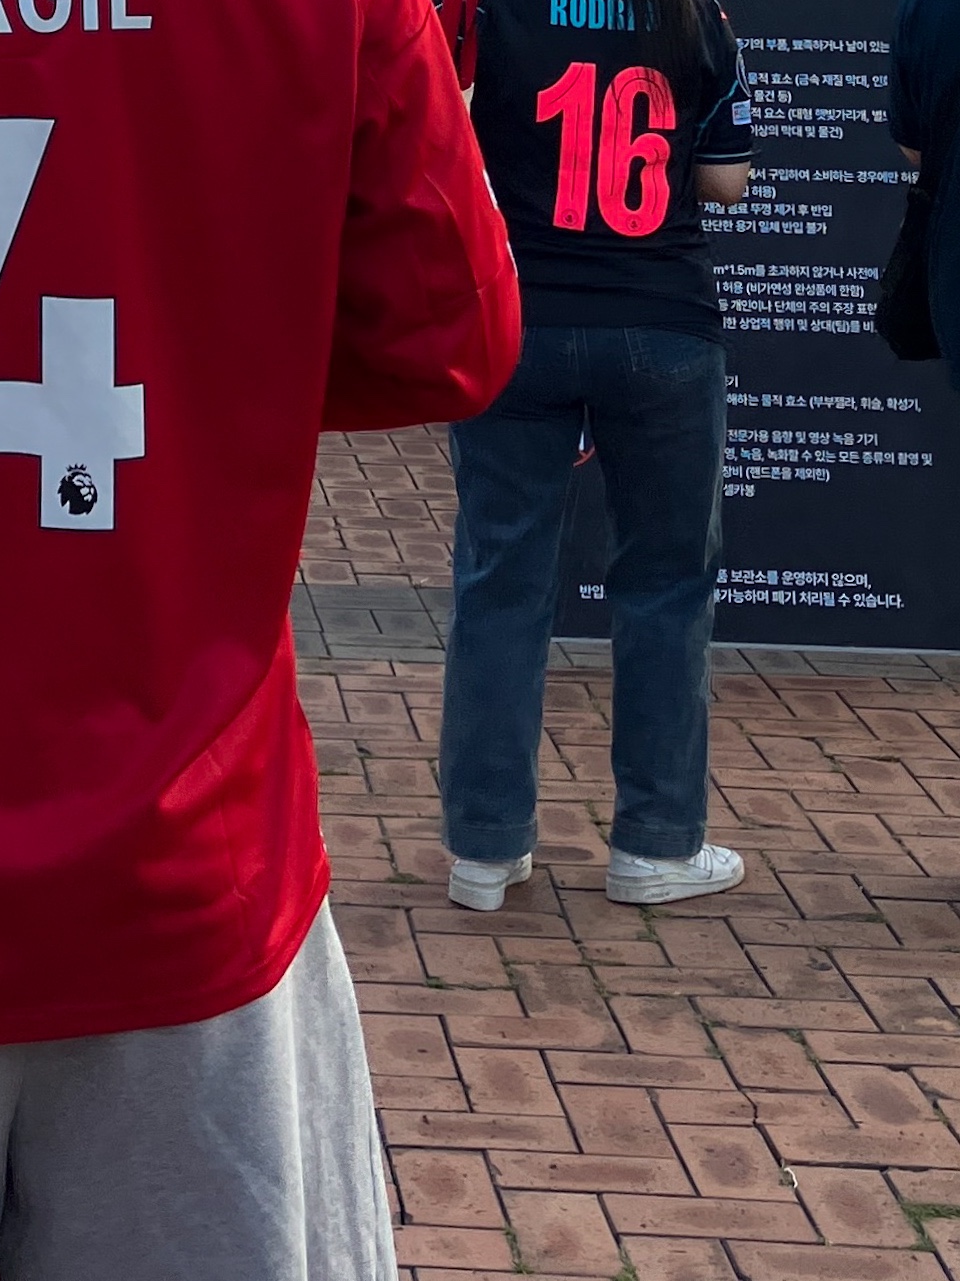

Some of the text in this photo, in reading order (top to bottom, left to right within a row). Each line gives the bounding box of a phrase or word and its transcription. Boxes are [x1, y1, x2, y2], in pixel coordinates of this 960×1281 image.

[536, 61, 677, 238] 16
[730, 570, 779, 585] 보관소를
[782, 571, 828, 586] 운영하지
[831, 573, 872, 589] 않으며,
[772, 590, 797, 605] 폐기
[799, 591, 835, 606] 처리될
[838, 593, 851, 607] 수
[854, 594, 905, 608] 있습니다.
